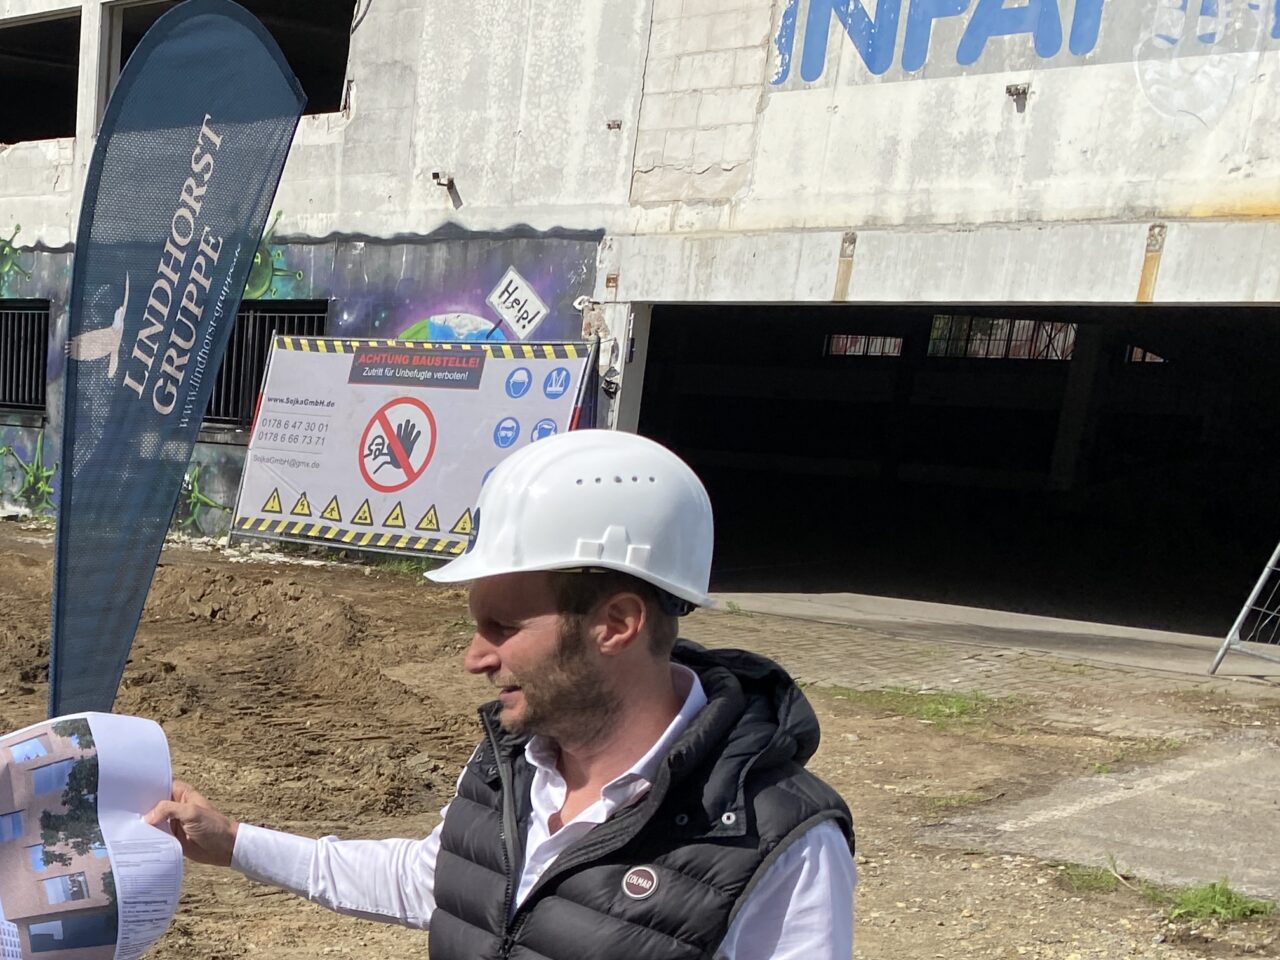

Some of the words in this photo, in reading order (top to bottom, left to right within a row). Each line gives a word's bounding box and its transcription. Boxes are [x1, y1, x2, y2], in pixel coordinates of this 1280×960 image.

[123, 113, 224, 399] LINDHORST
[498, 279, 541, 330] Help!
[153, 226, 223, 415] GRUPPE
[358, 353, 409, 365] ACHTUNG
[412, 355, 480, 368] BAUSTELLE!
[363, 367, 384, 376] Zutritt
[384, 367, 395, 377] für
[395, 368, 432, 380] Unbefugte
[433, 370, 469, 381] verboten!
[262, 418, 282, 429] 0178
[283, 420, 290, 430] 6
[291, 421, 303, 430] 47
[304, 422, 316, 432] 30
[317, 423, 329, 433] 01
[258, 431, 279, 442] 0178
[280, 433, 287, 443] 6
[288, 434, 299, 444] 66
[302, 435, 313, 445] 73
[315, 436, 326, 447] 71
[626, 874, 653, 890] COLMAR
